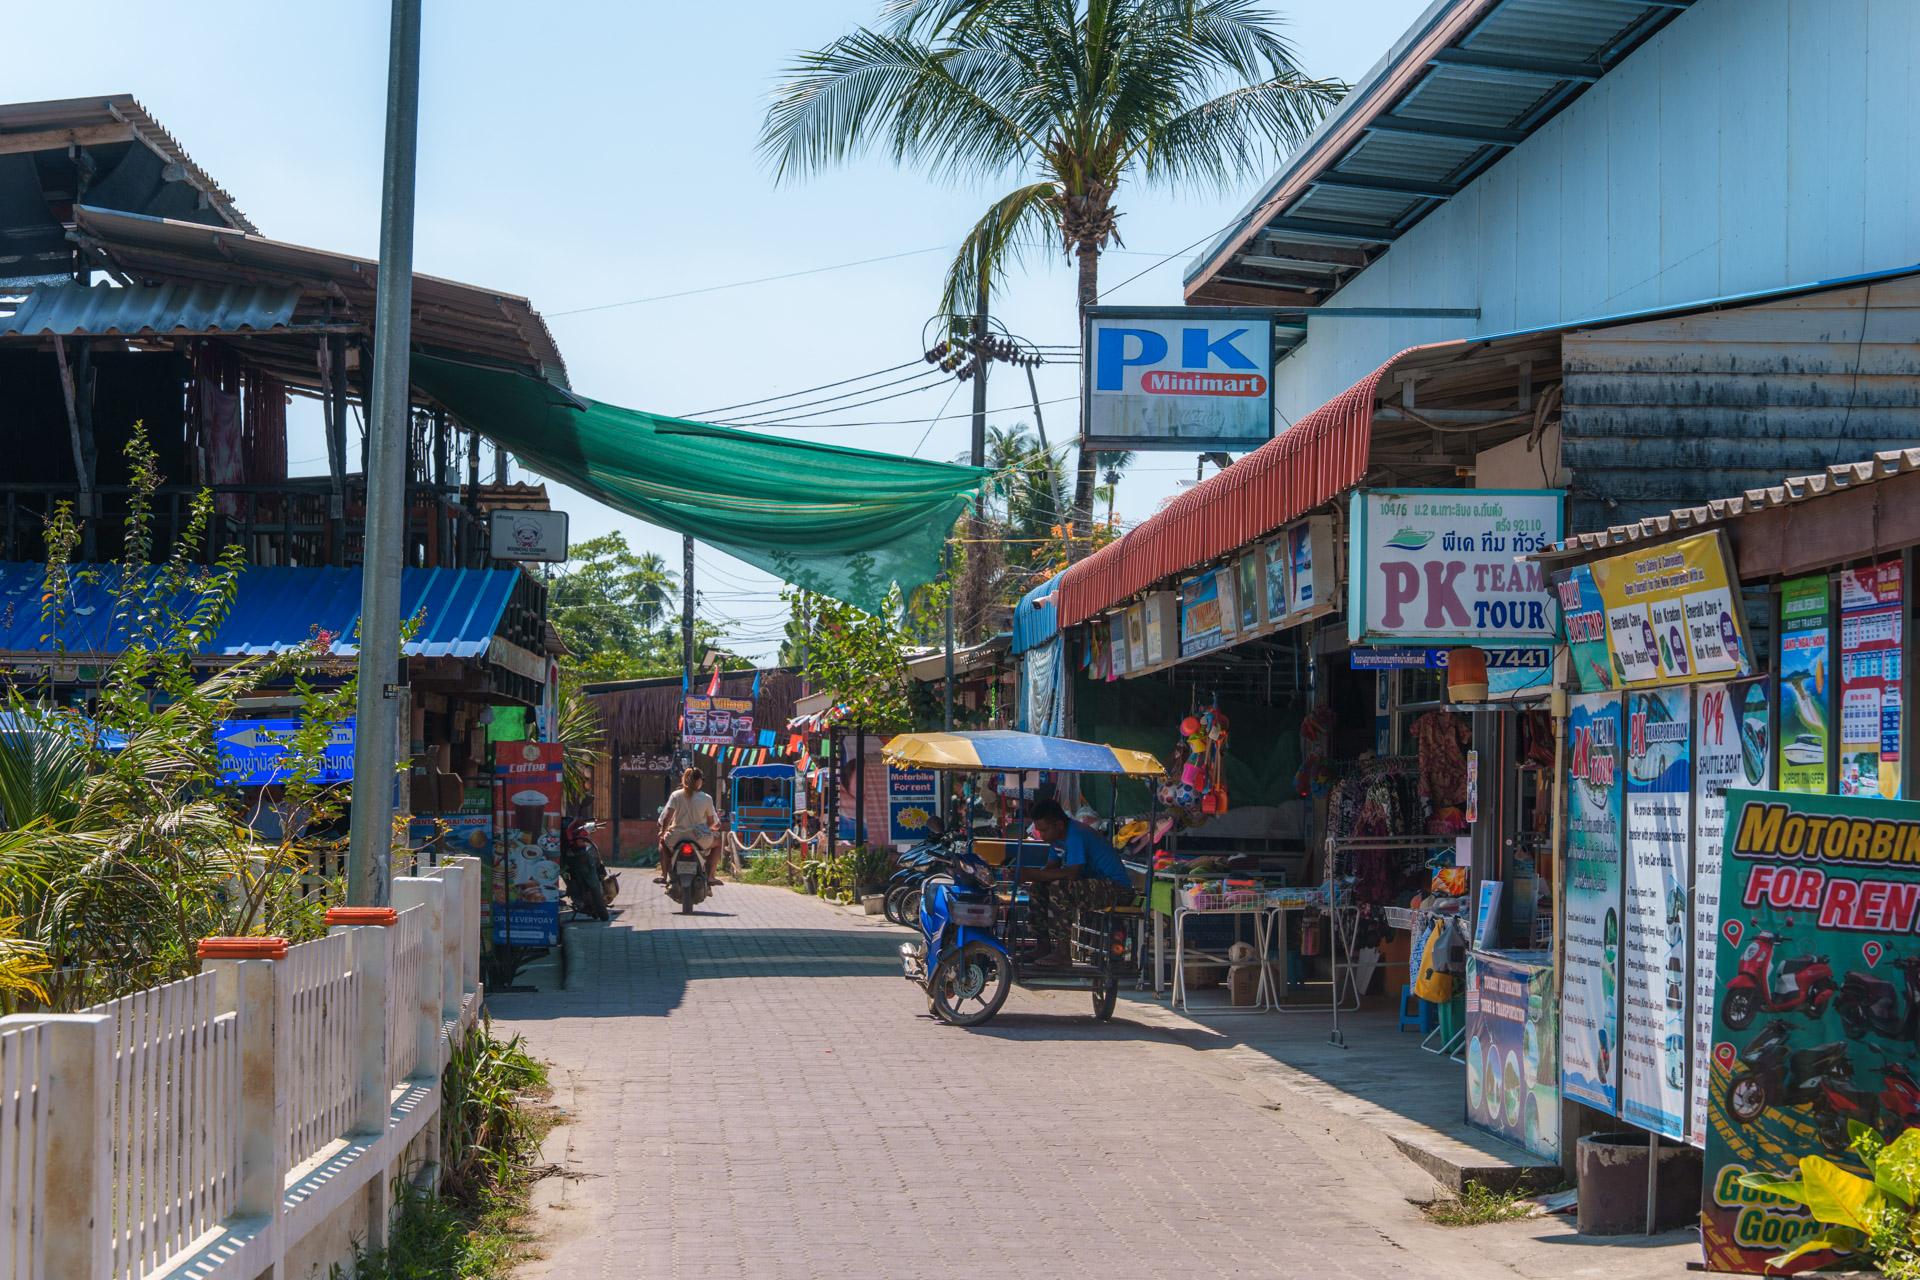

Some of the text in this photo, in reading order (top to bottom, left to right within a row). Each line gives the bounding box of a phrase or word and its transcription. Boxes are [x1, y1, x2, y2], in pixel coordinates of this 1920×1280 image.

[1097, 328, 1260, 390] PK
[1151, 374, 1259, 392] Minimart
[1380, 503, 1407, 516] 104/6
[1513, 519, 1541, 532] 92110
[1442, 530, 1546, 553] พีเค ทีม ทัวร์
[1380, 560, 1545, 629] PK TEAM
[1558, 578, 1582, 611] DAILY
[1474, 600, 1545, 629] TOUR
[1653, 606, 1680, 625] Koh Kradan
[1685, 601, 1703, 619] Emerald
[1704, 600, 1718, 617] Cave
[1584, 609, 1604, 642] TRIP
[1611, 612, 1642, 630] Emerald Cave
[1690, 623, 1703, 642] Tiger
[1703, 622, 1716, 638] Cave
[1695, 643, 1722, 660] Koh Kradan
[712, 697, 753, 713] Village
[1702, 690, 1725, 746] PK
[1631, 711, 1688, 757] PK TRANSPORTATION
[1573, 716, 1615, 778] PK TEAM
[509, 763, 546, 773] Coffee
[1591, 754, 1615, 786] TOUR
[1699, 753, 1741, 775] SHUTTLE BOAT
[891, 773, 935, 781] Motorbike
[894, 783, 931, 791] For rent
[464, 817, 488, 825] MOOK
[1746, 867, 1824, 907] FOR
[514, 915, 554, 924] EVERYDAY
